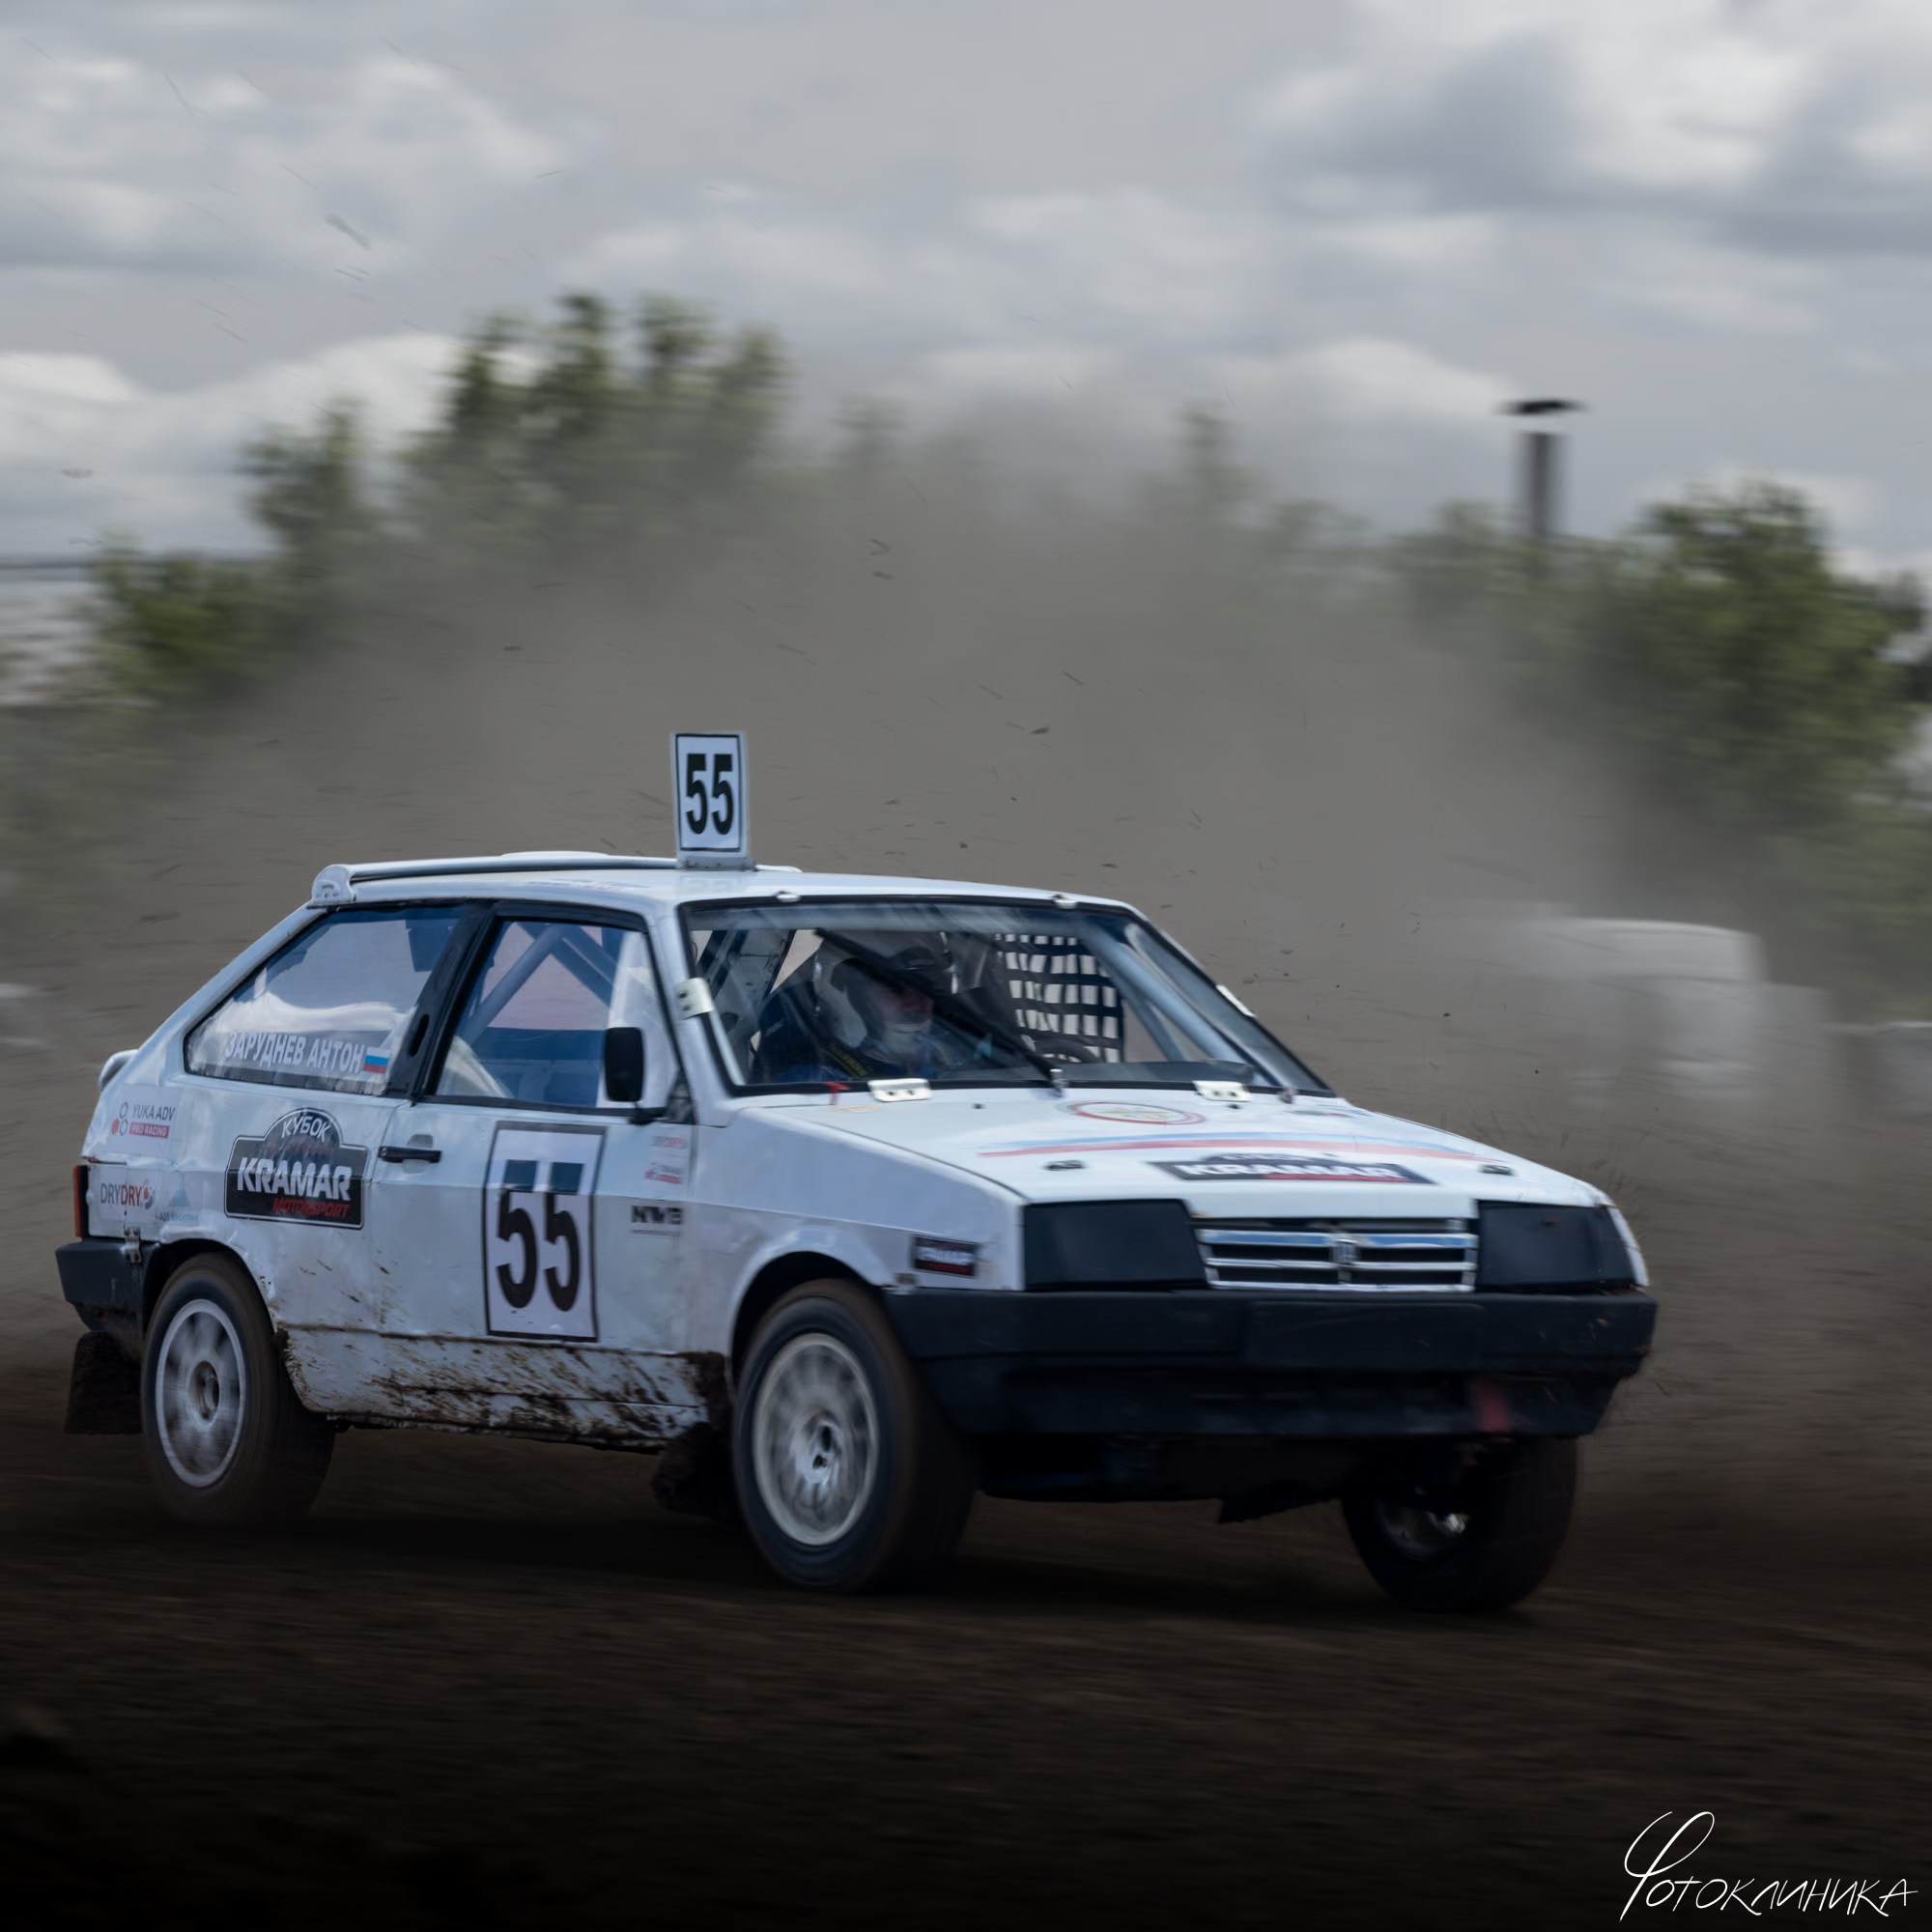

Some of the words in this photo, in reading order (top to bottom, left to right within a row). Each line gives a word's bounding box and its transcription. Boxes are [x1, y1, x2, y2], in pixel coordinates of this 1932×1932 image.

[686, 753, 734, 836] 55
[224, 1031, 307, 1067] ЗАРУДНЕВ
[307, 1037, 365, 1074] АНТОН
[155, 1107, 176, 1121] ADV
[281, 1116, 331, 1143] КУБОК
[237, 1157, 353, 1201] KRAMAR
[271, 1198, 351, 1218] MOTORSPORT
[497, 1159, 585, 1312] 55
